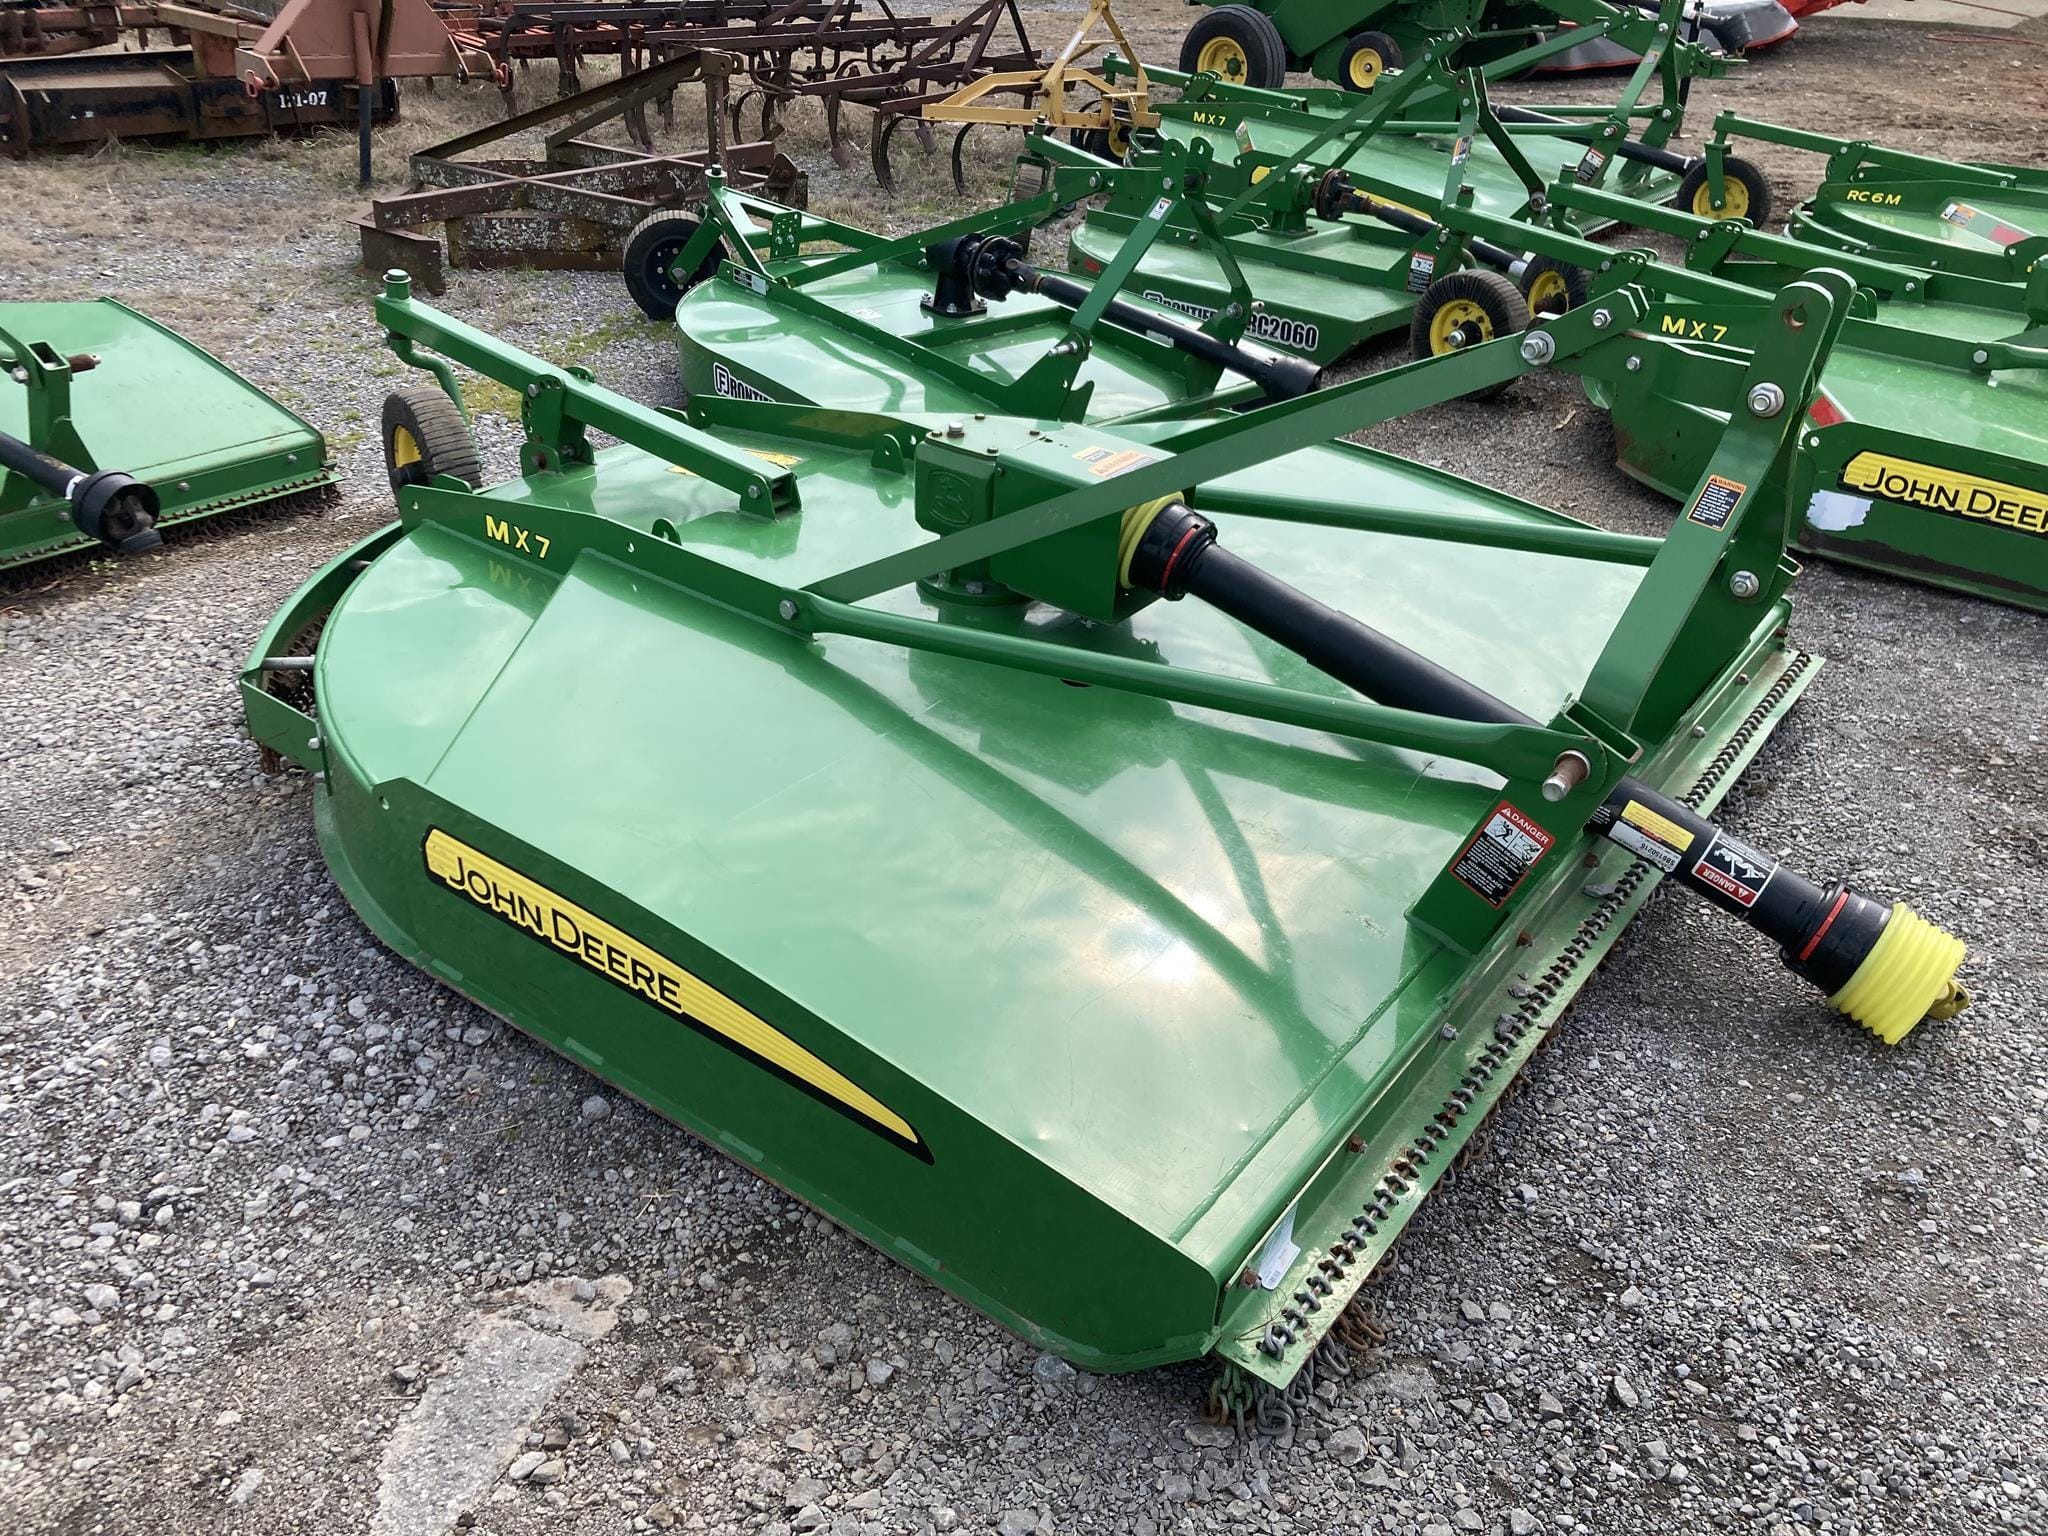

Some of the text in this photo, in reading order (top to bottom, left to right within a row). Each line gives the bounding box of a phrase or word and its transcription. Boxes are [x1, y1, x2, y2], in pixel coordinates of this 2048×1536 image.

[1193, 111, 1226, 126] MX7
[1846, 190, 1901, 205] RC6M
[1661, 315, 1728, 342] MX7
[1863, 467, 2048, 530] JOHN DEE
[486, 515, 550, 559] MX7
[1511, 814, 1549, 844] DANGER
[1702, 868, 1737, 892] DANGER
[450, 857, 683, 1010] JOHN DEERE
